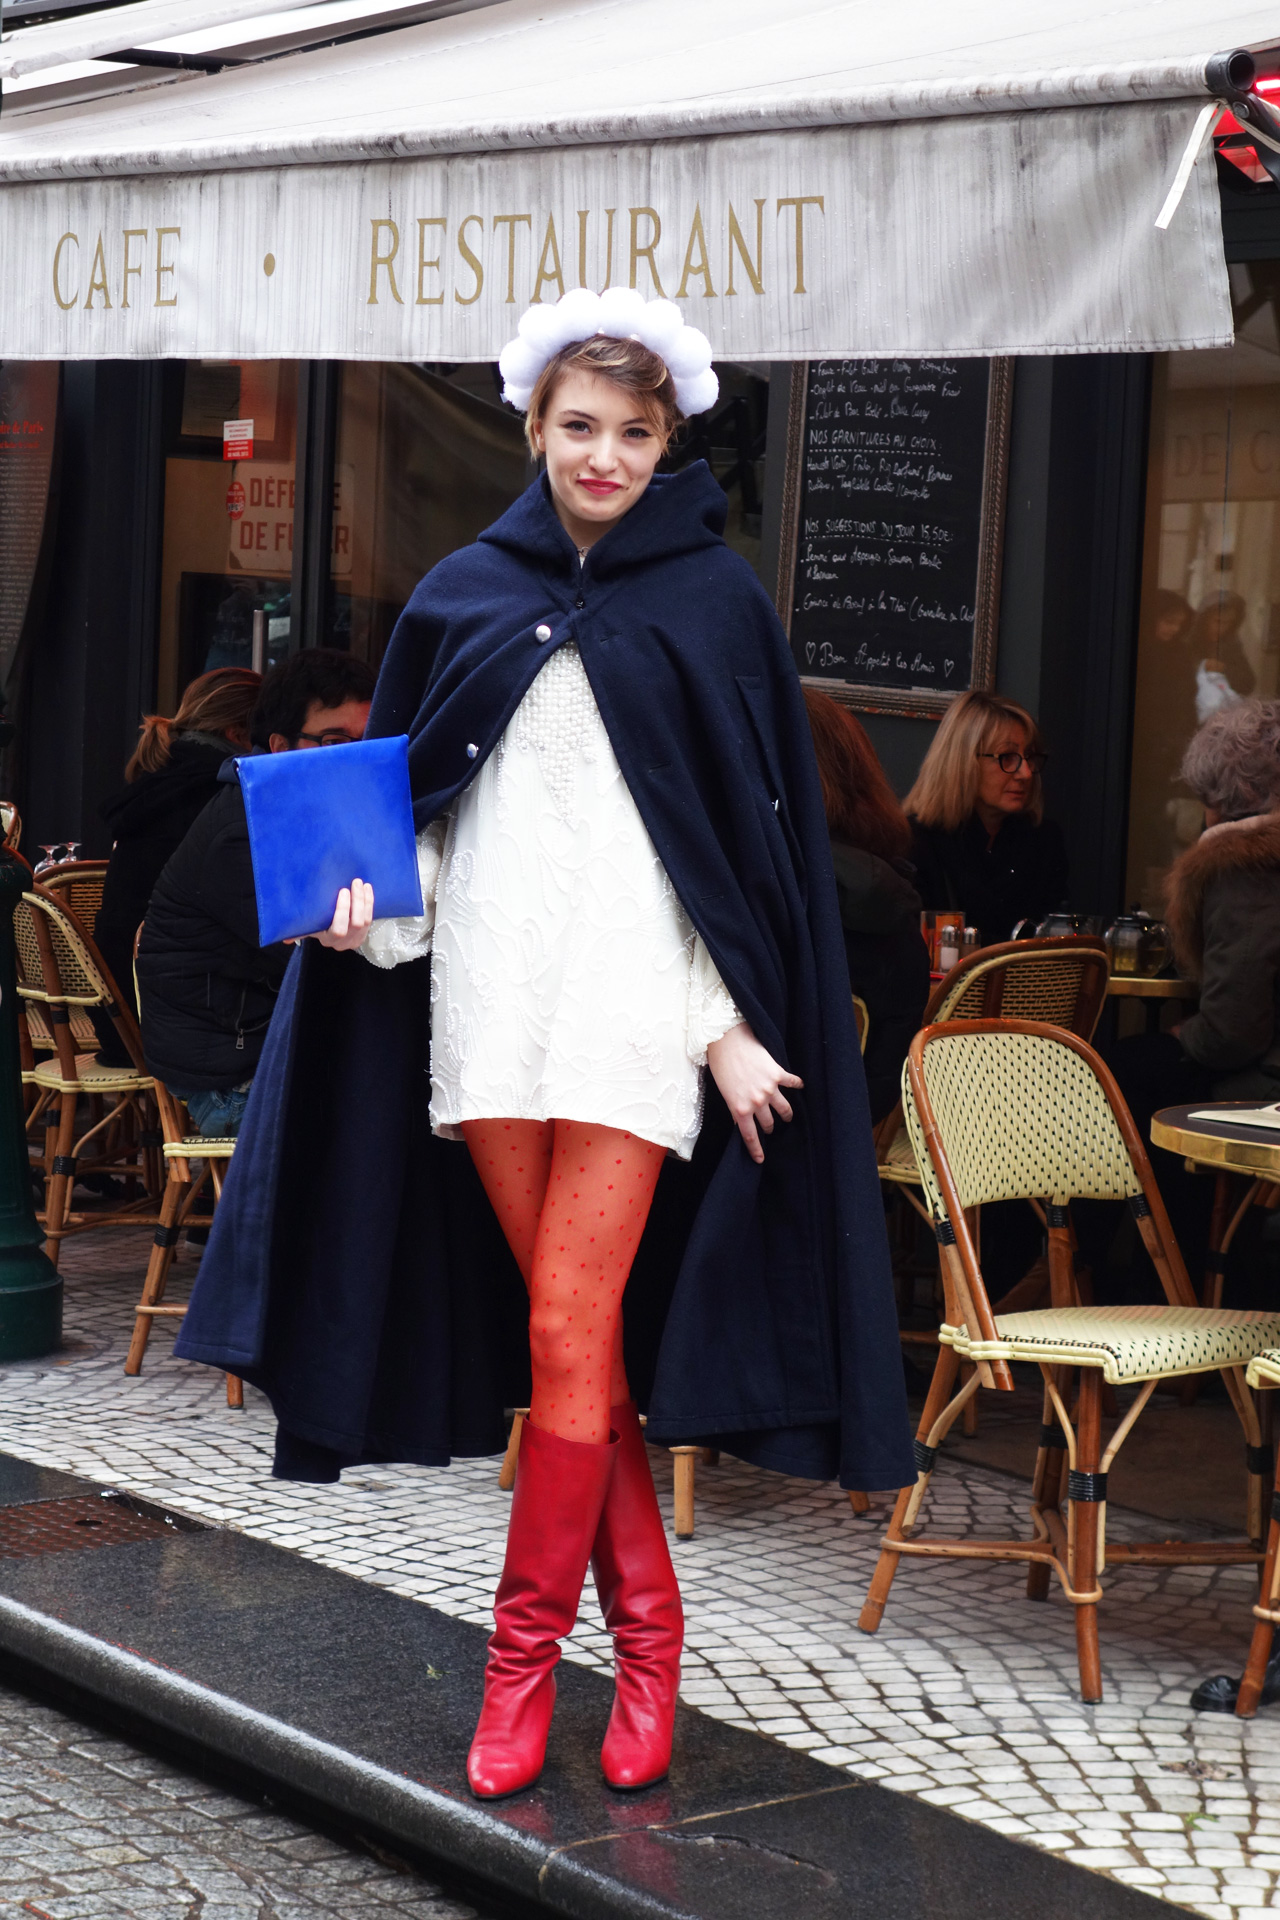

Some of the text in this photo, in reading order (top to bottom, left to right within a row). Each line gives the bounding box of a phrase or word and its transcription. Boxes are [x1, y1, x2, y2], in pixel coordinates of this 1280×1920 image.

[53, 195, 825, 311] CAFE RESTAURANT
[809, 429, 828, 445] NOS
[831, 429, 890, 446] GARNITURES
[893, 434, 906, 447] AU
[240, 521, 268, 550] DE
[805, 517, 819, 536] NOS
[825, 518, 876, 534] SUGGESTIONS
[881, 521, 893, 537] DU
[895, 524, 915, 538] JOUR
[819, 641, 848, 667] Bon
[910, 652, 936, 673] Amis
